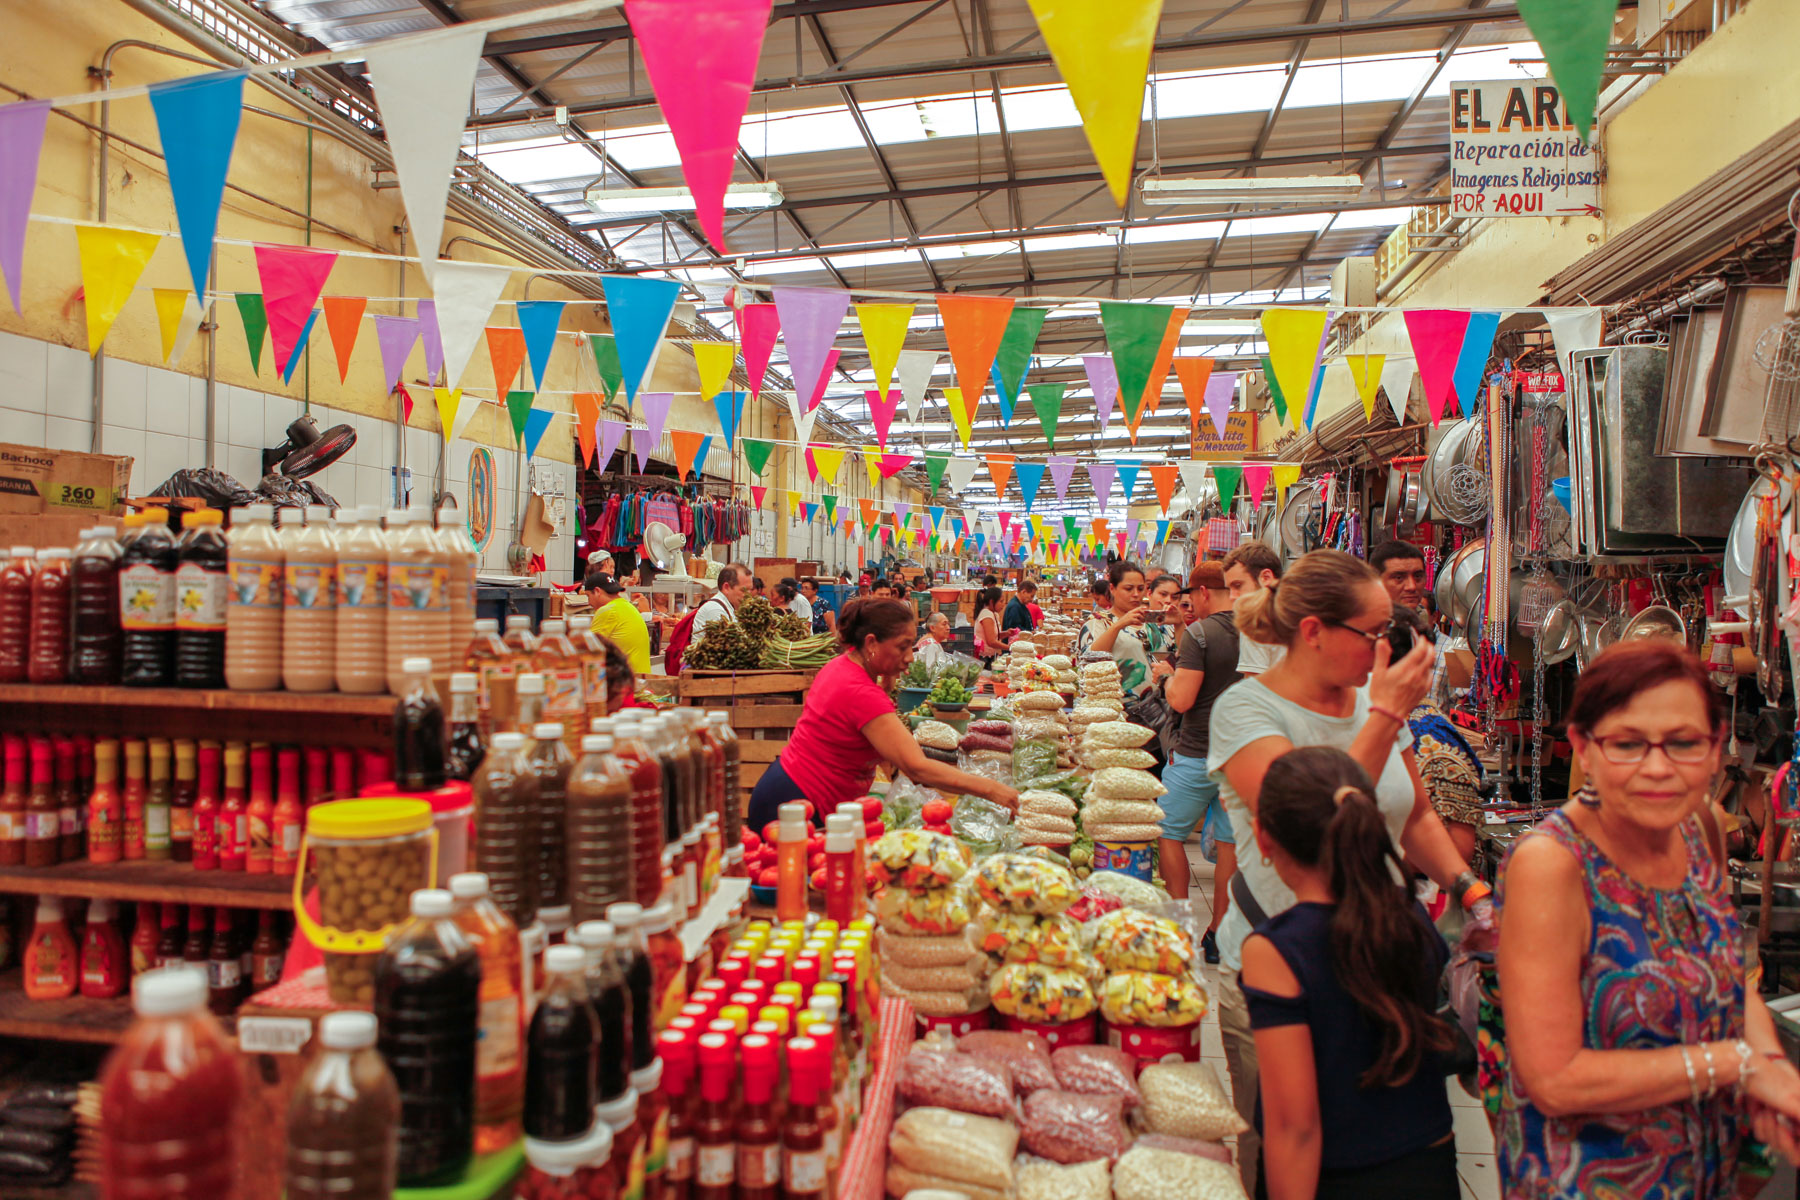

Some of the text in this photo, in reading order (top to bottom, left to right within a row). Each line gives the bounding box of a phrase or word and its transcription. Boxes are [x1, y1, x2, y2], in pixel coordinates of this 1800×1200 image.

[1452, 86, 1598, 133] EL AR
[1454, 137, 1589, 165] Reparación de
[1452, 166, 1601, 194] Imagenes Religiosas
[1453, 193, 1486, 213] POR
[1, 452, 54, 466] Bachoco
[61, 485, 96, 500] 360
